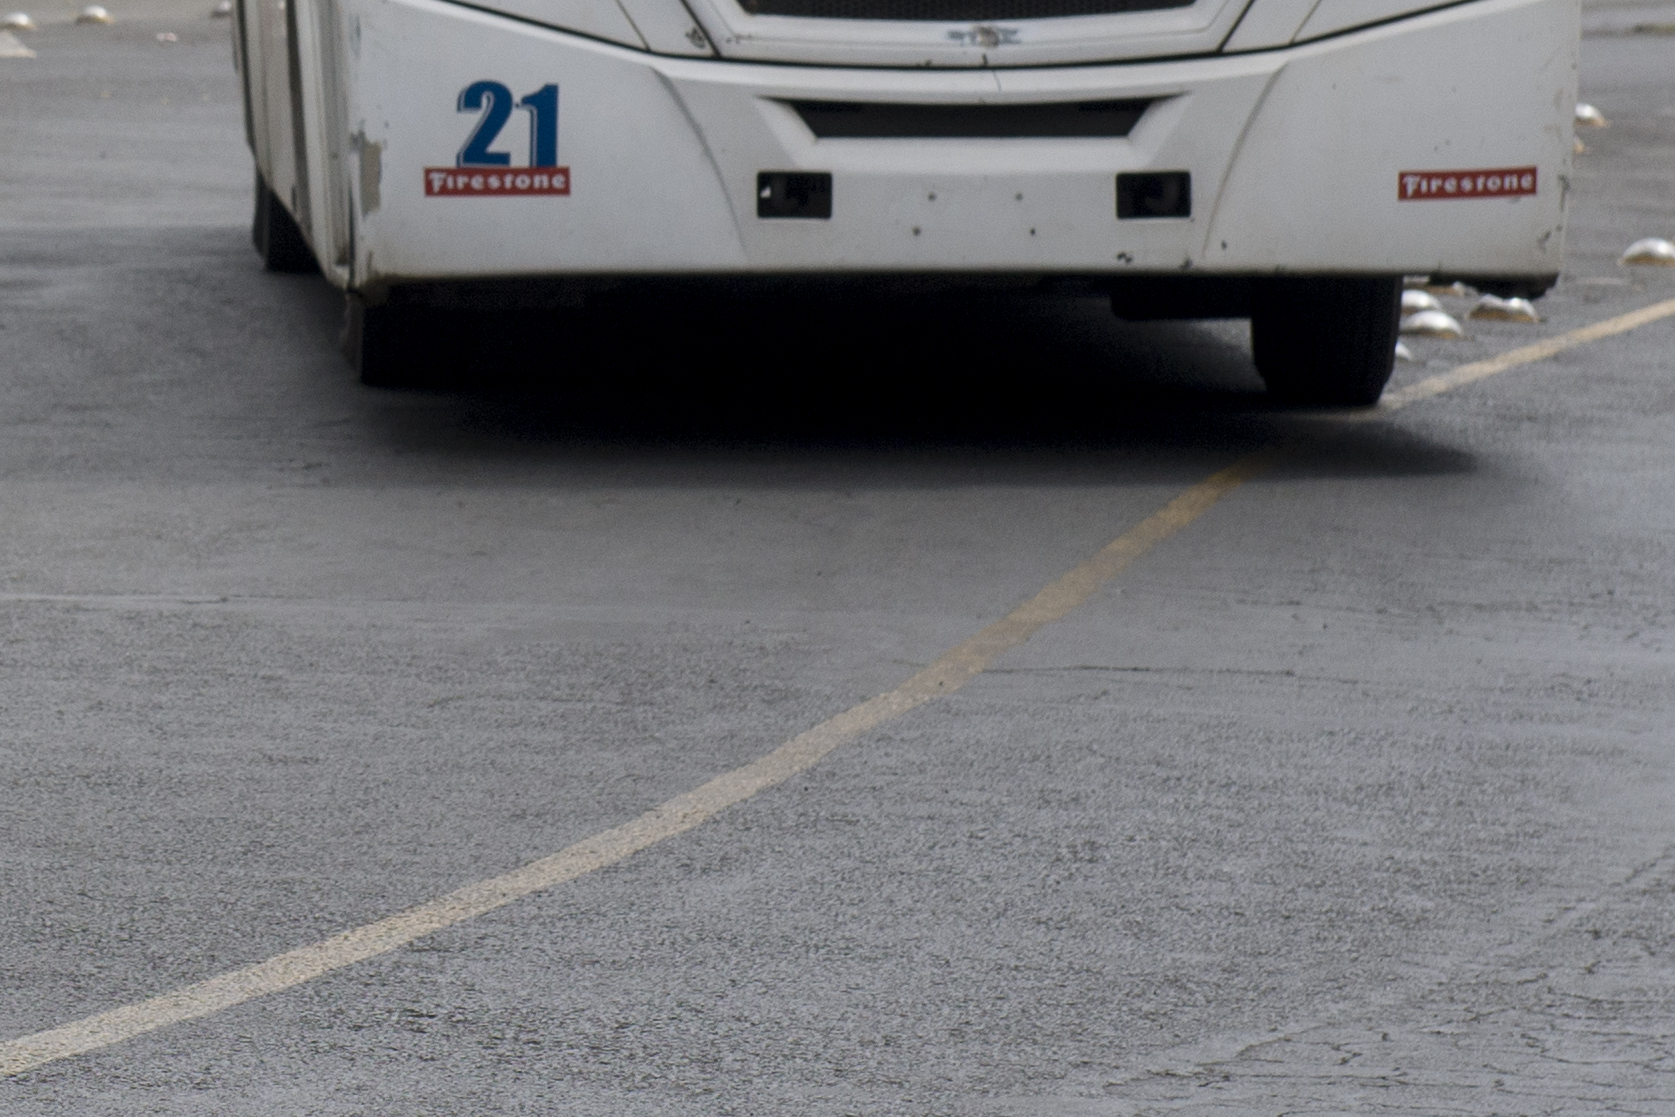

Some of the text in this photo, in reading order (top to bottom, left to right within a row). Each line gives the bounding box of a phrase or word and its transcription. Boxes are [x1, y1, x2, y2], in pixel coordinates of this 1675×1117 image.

[456, 80, 559, 169] 21
[428, 170, 567, 194] Firestone
[1402, 172, 1536, 199] Firestone
